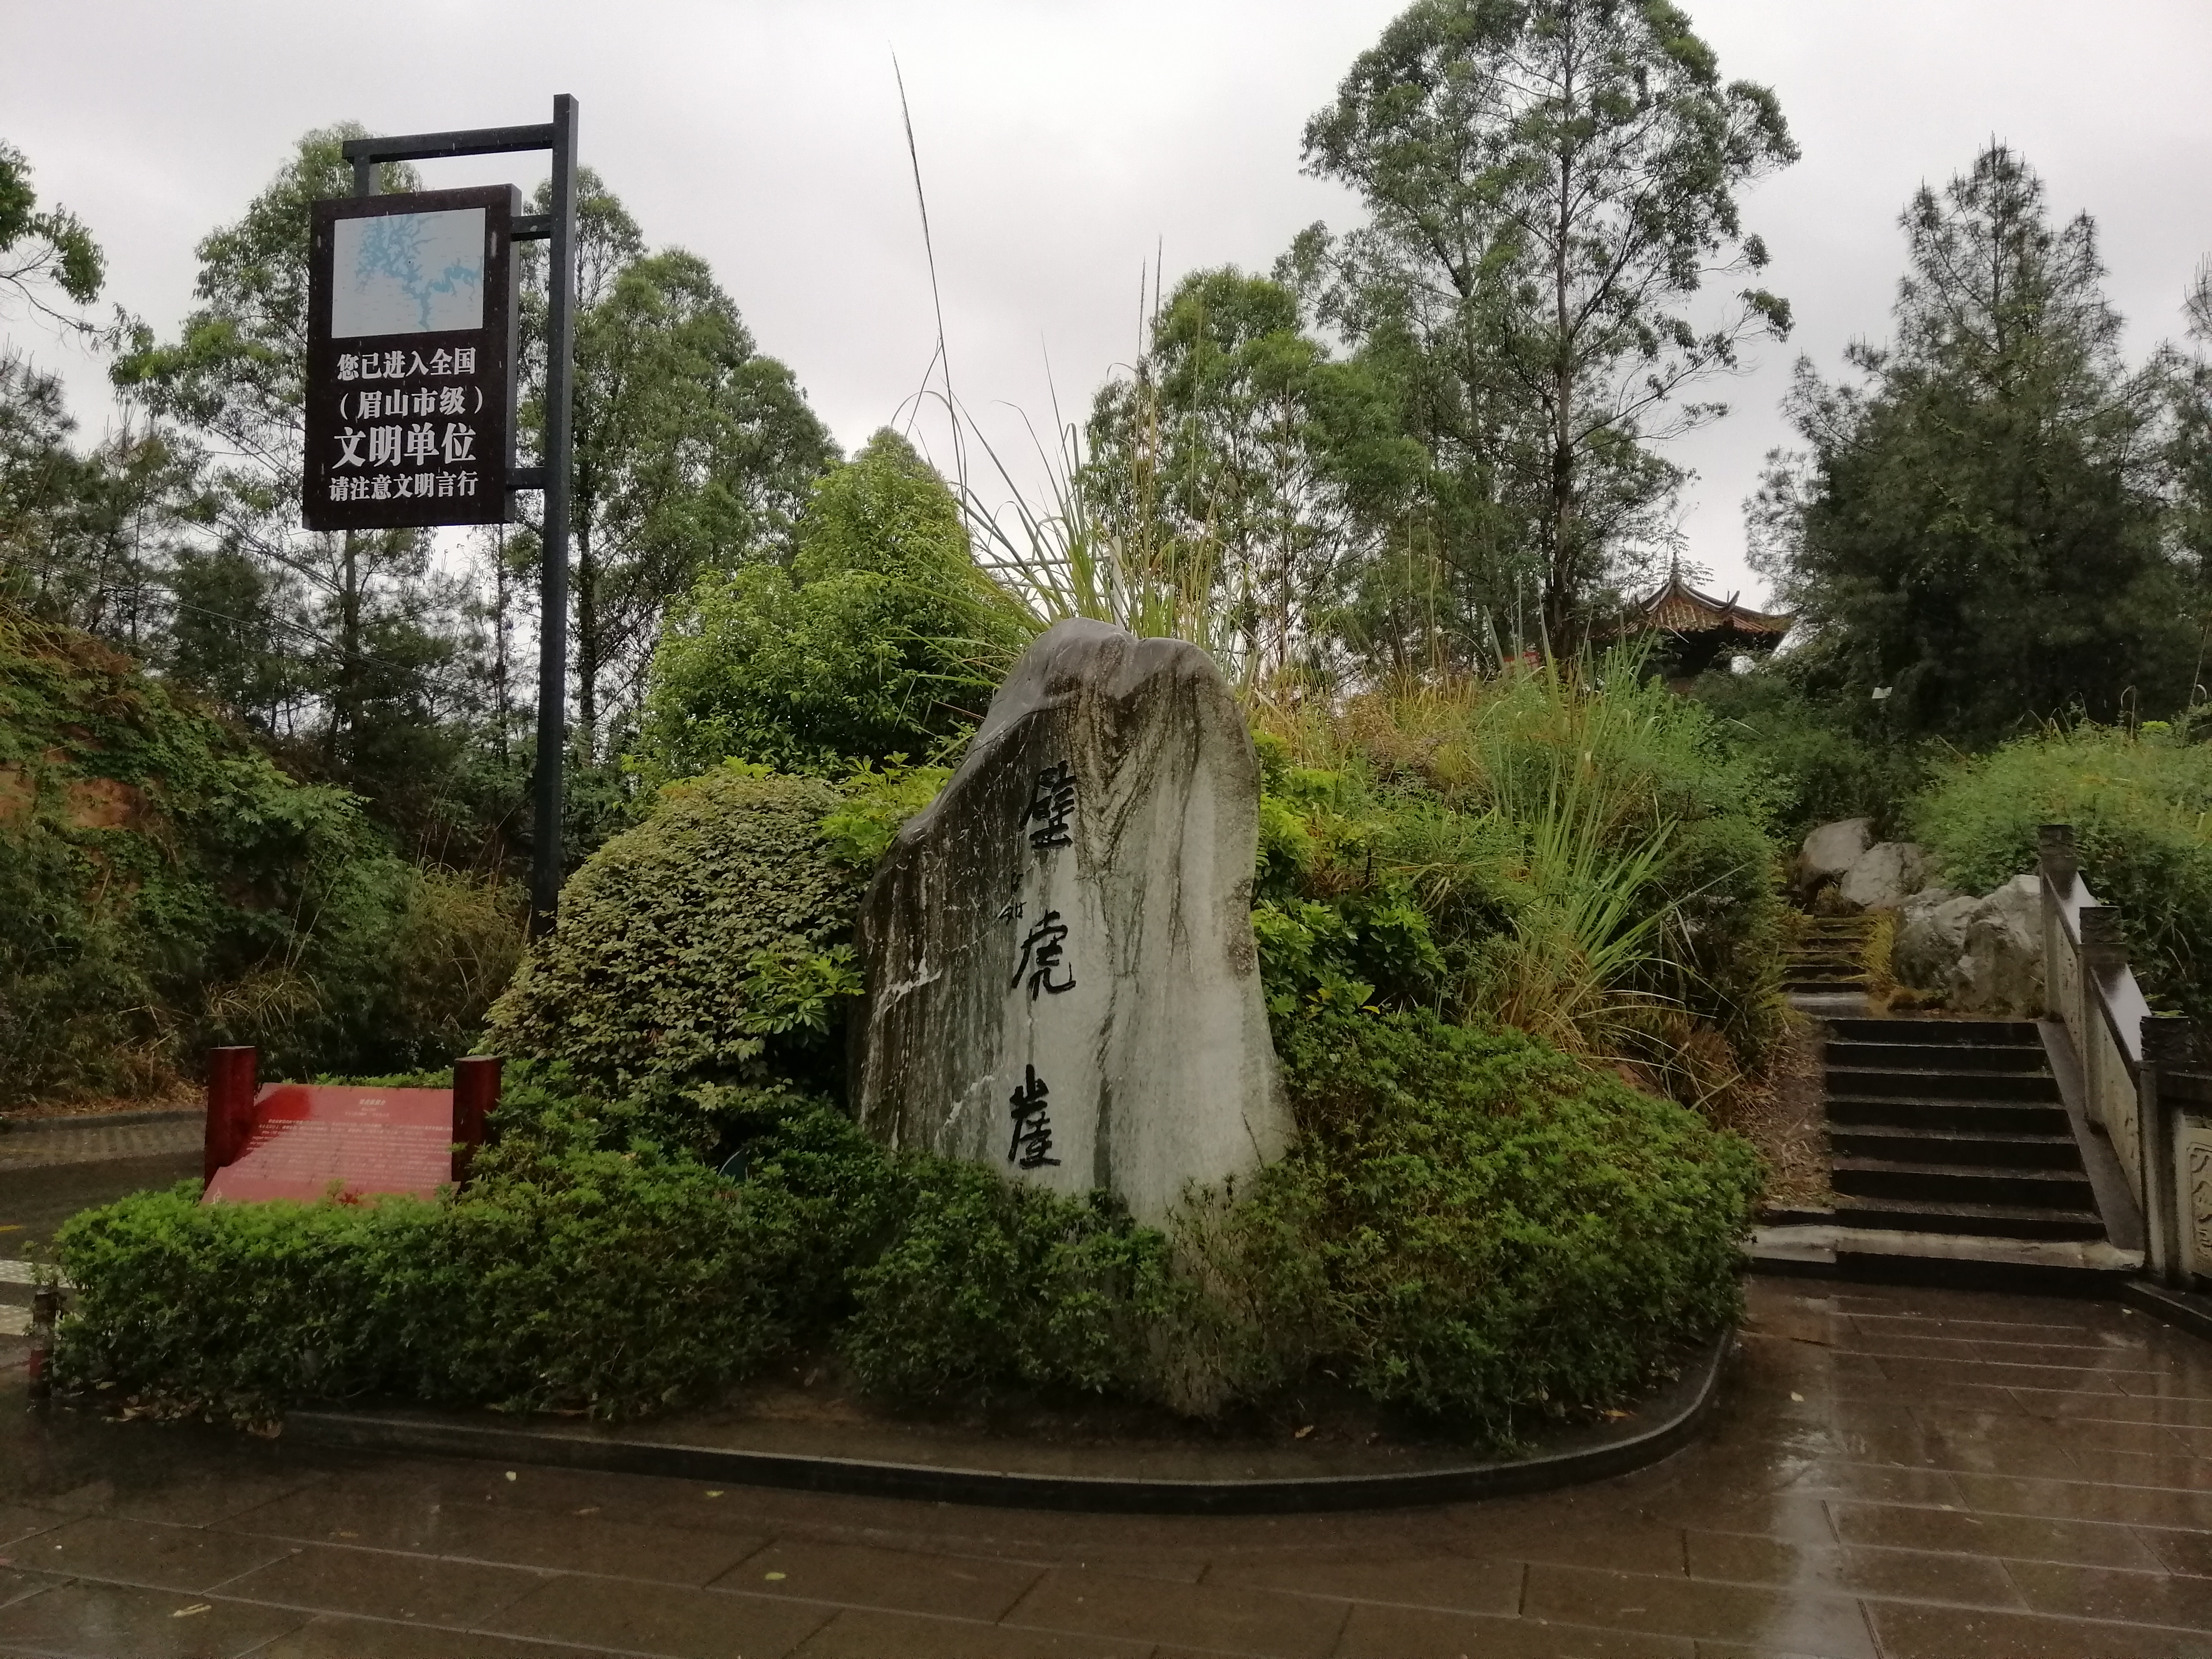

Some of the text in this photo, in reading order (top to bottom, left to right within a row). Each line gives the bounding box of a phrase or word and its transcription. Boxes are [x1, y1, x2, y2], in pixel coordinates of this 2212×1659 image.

[337, 347, 476, 381] 您已进入全国
[332, 423, 476, 469] 文明单位
[329, 471, 478, 501] 请注意文明言行
